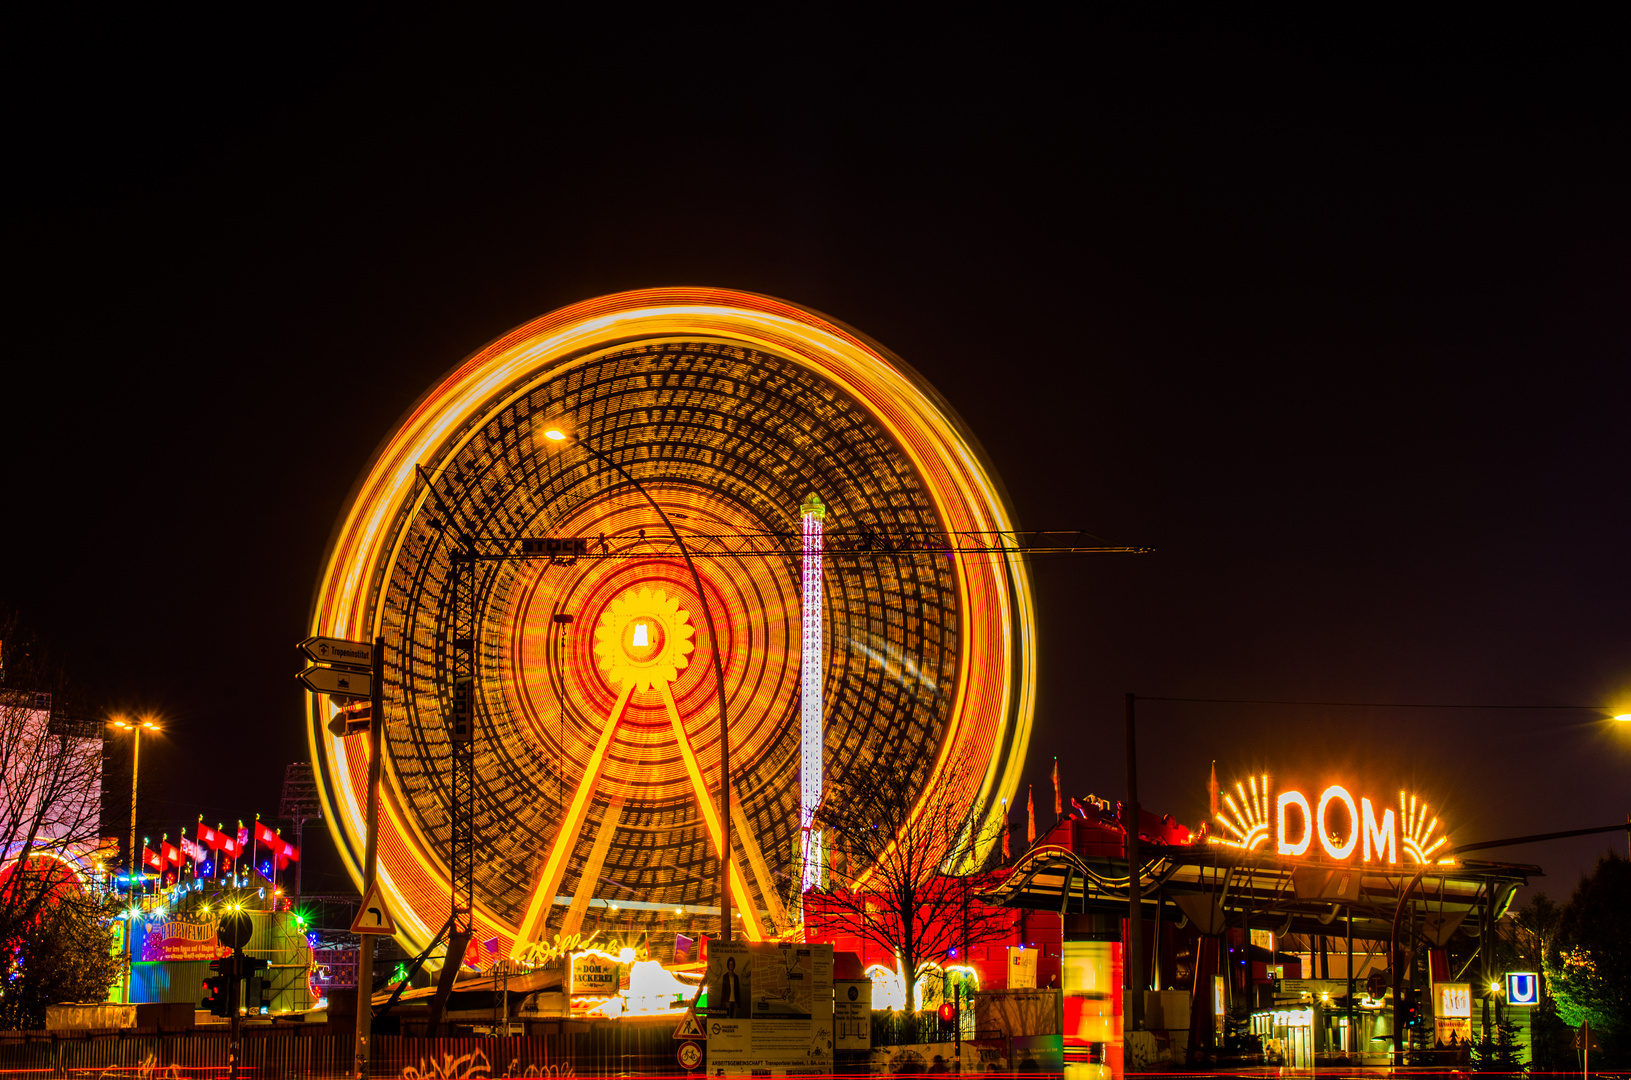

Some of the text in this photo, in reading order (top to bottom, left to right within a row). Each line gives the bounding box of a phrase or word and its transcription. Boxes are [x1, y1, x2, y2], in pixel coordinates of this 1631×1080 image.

[523, 538, 587, 552] STOCK
[331, 646, 369, 660] Tropeninstitut
[453, 682, 467, 735] STOCK
[1277, 785, 1396, 864] DOM
[161, 921, 186, 940] HAPPY
[187, 921, 215, 941] FAMILY
[583, 965, 601, 973] DOM
[1512, 975, 1533, 1002] U
